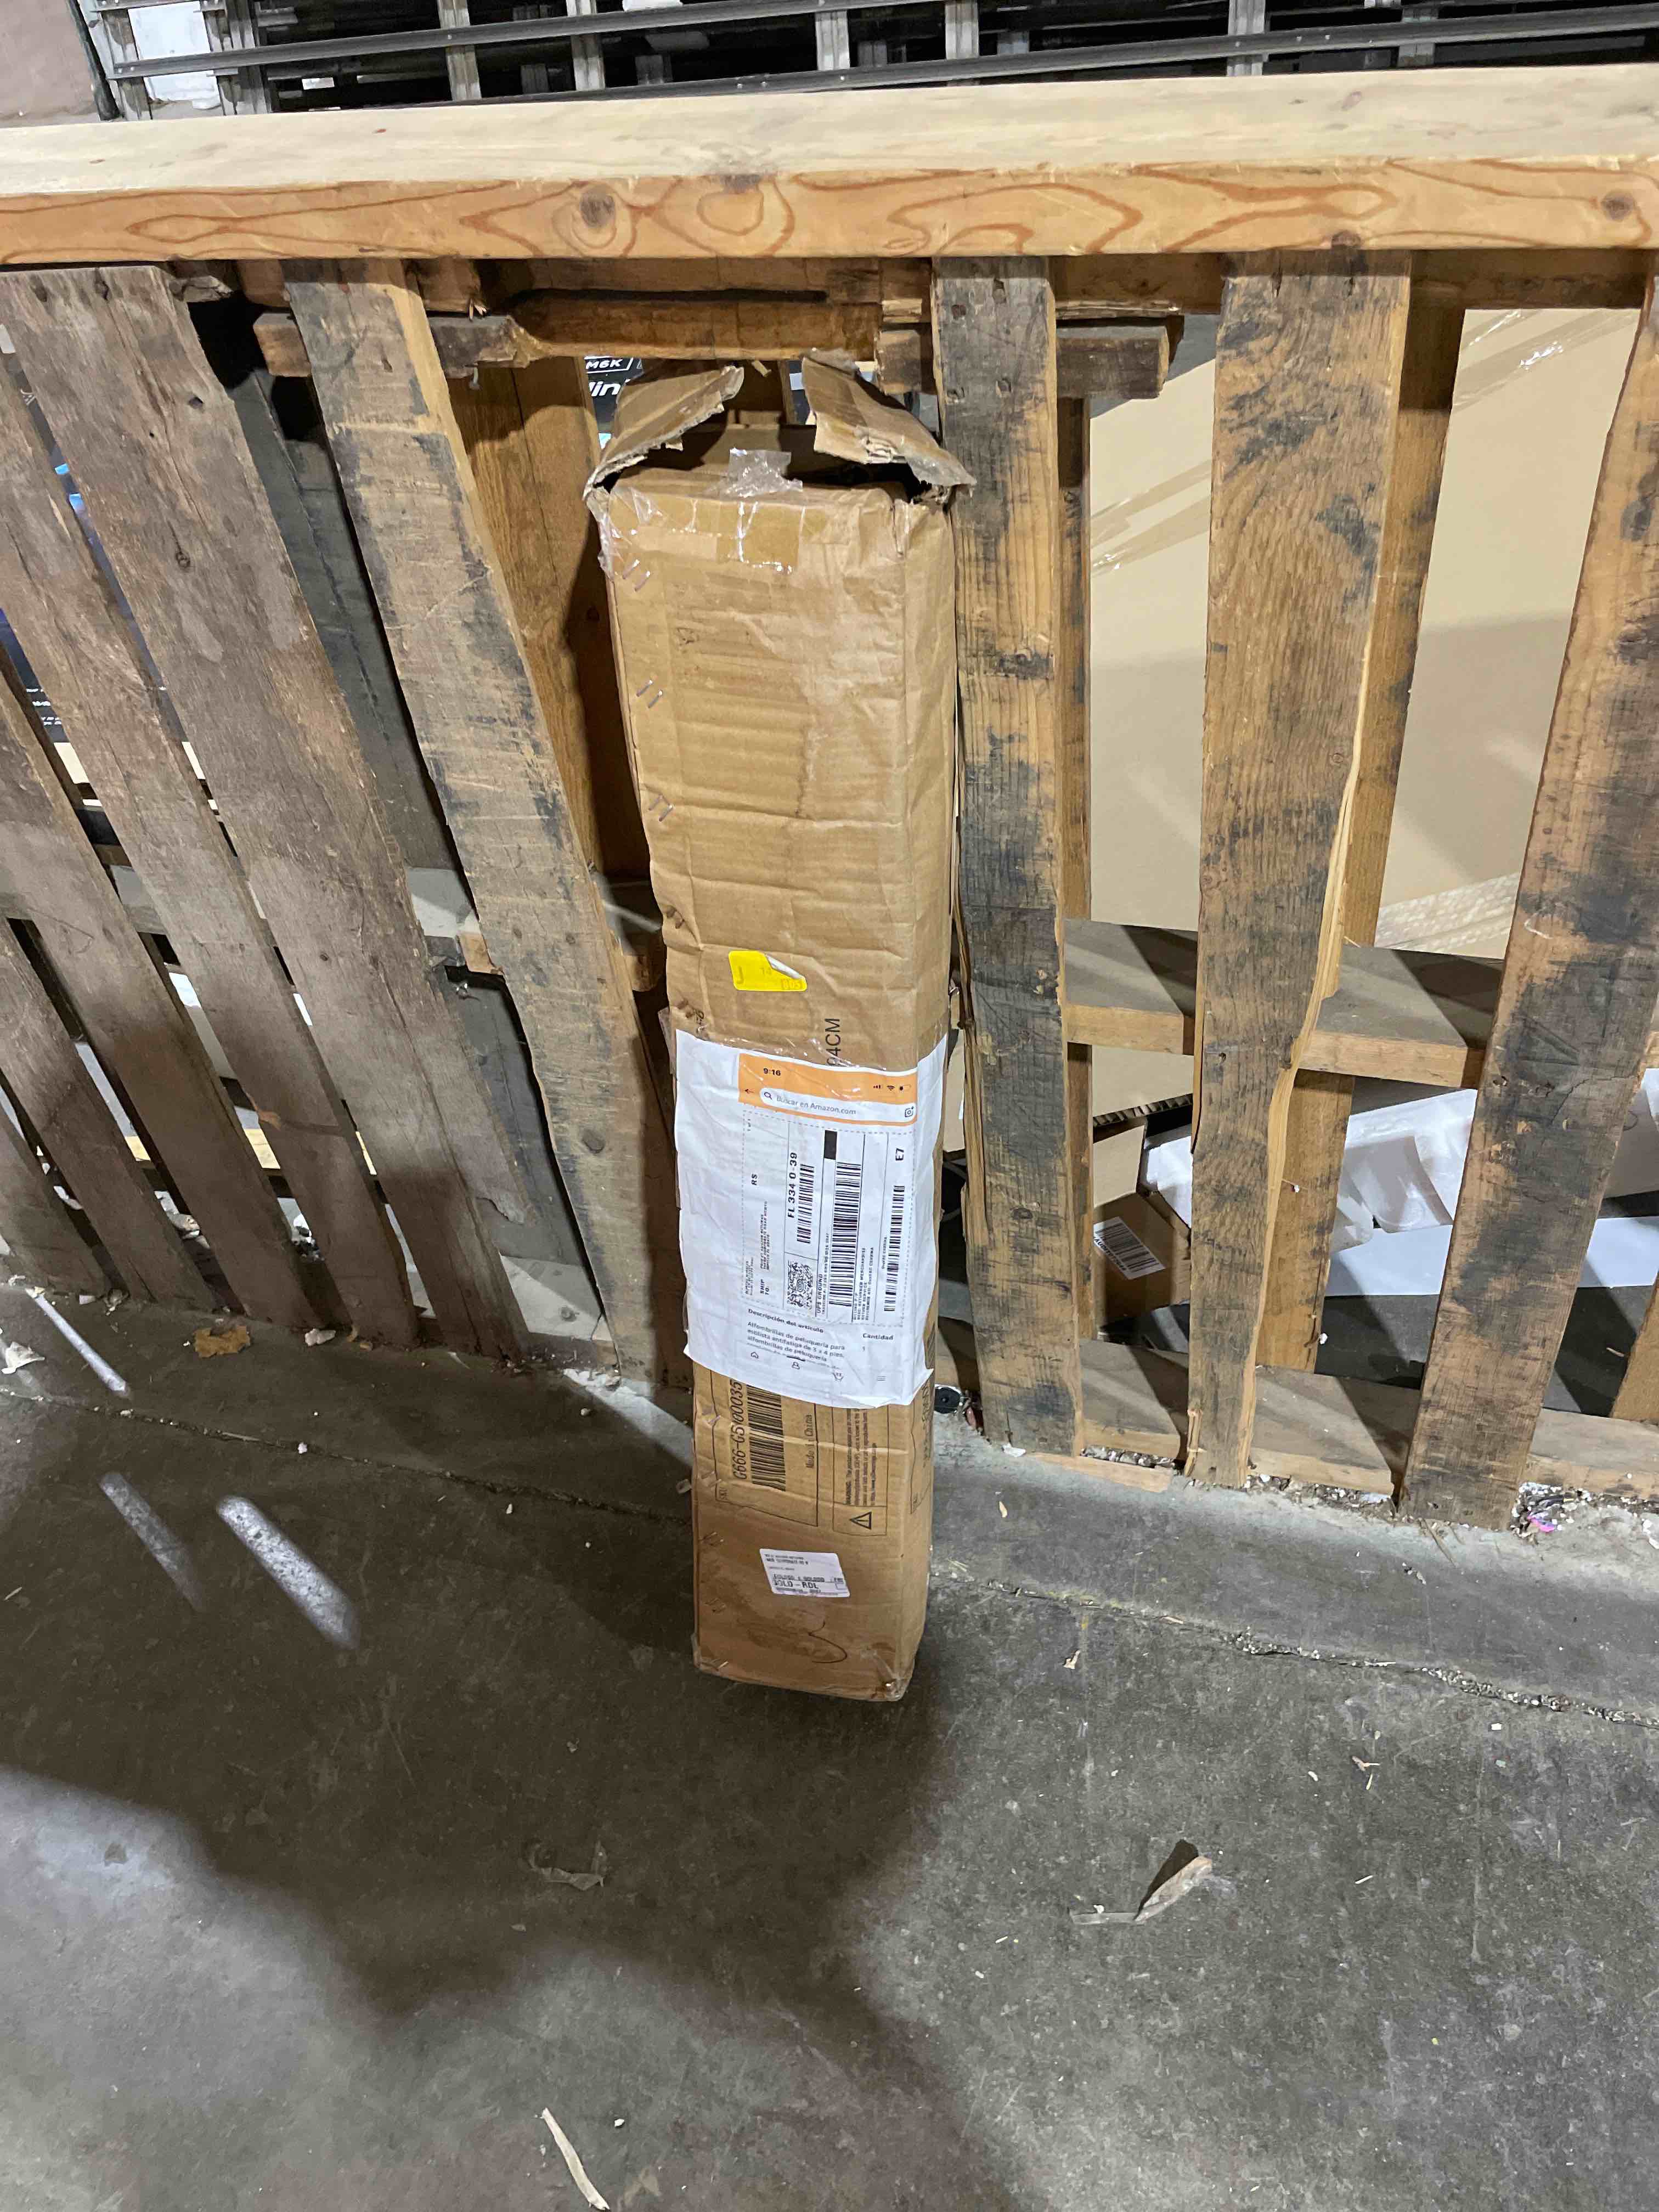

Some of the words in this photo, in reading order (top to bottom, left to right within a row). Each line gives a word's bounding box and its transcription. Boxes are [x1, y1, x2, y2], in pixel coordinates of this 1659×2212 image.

[763, 1068, 781, 1076] 9:16
[776, 1096, 798, 1106] Buscar
[810, 1103, 856, 1115] Amazon.com
[895, 1147, 904, 1161] E7
[751, 1173, 758, 1185] RS
[787, 1207, 795, 1217] FL
[748, 1308, 785, 1323] Descripción
[748, 1321, 784, 1337] Alfombrillas
[747, 1335, 783, 1350] alfombrillas
[772, 1336, 802, 1348] antifatiga
[804, 1414, 813, 1436] China
[804, 1450, 815, 1468] Made
